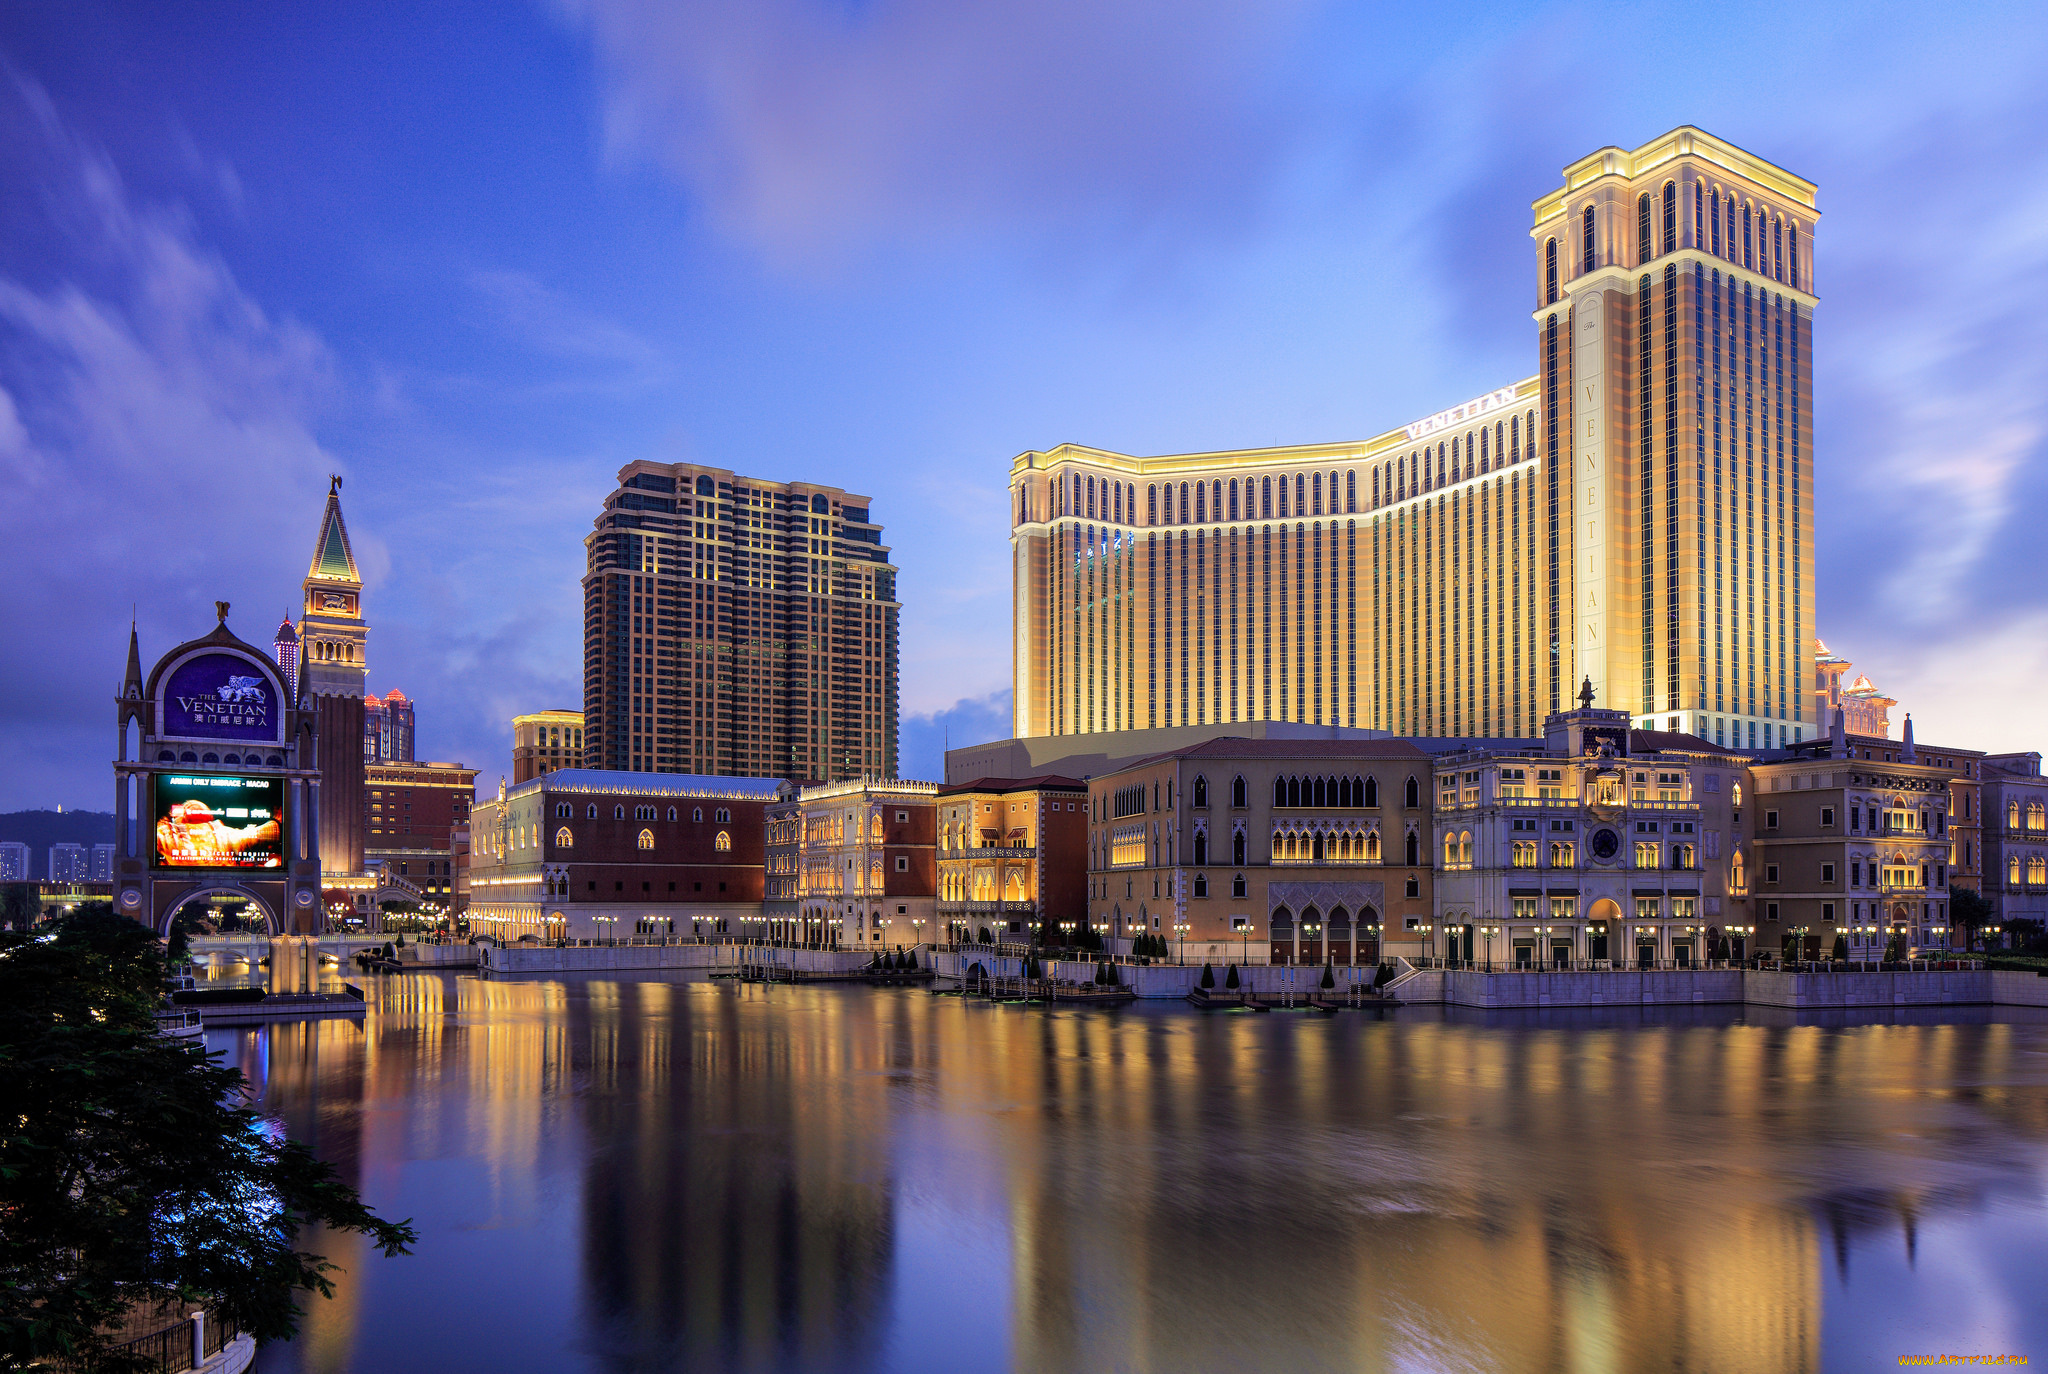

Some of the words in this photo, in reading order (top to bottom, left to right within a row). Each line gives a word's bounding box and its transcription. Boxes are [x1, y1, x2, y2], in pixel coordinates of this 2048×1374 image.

[1583, 321, 1597, 331] The
[1407, 385, 1516, 440] VENETIAN
[1585, 384, 1598, 642] VENETIAN
[199, 693, 216, 701] THE
[176, 696, 267, 716] VENETIAN
[194, 713, 267, 727] 澳门威尼斯人
[193, 778, 210, 786] ONLY
[210, 779, 241, 787] EMBRACE
[246, 780, 269, 788] MACAO
